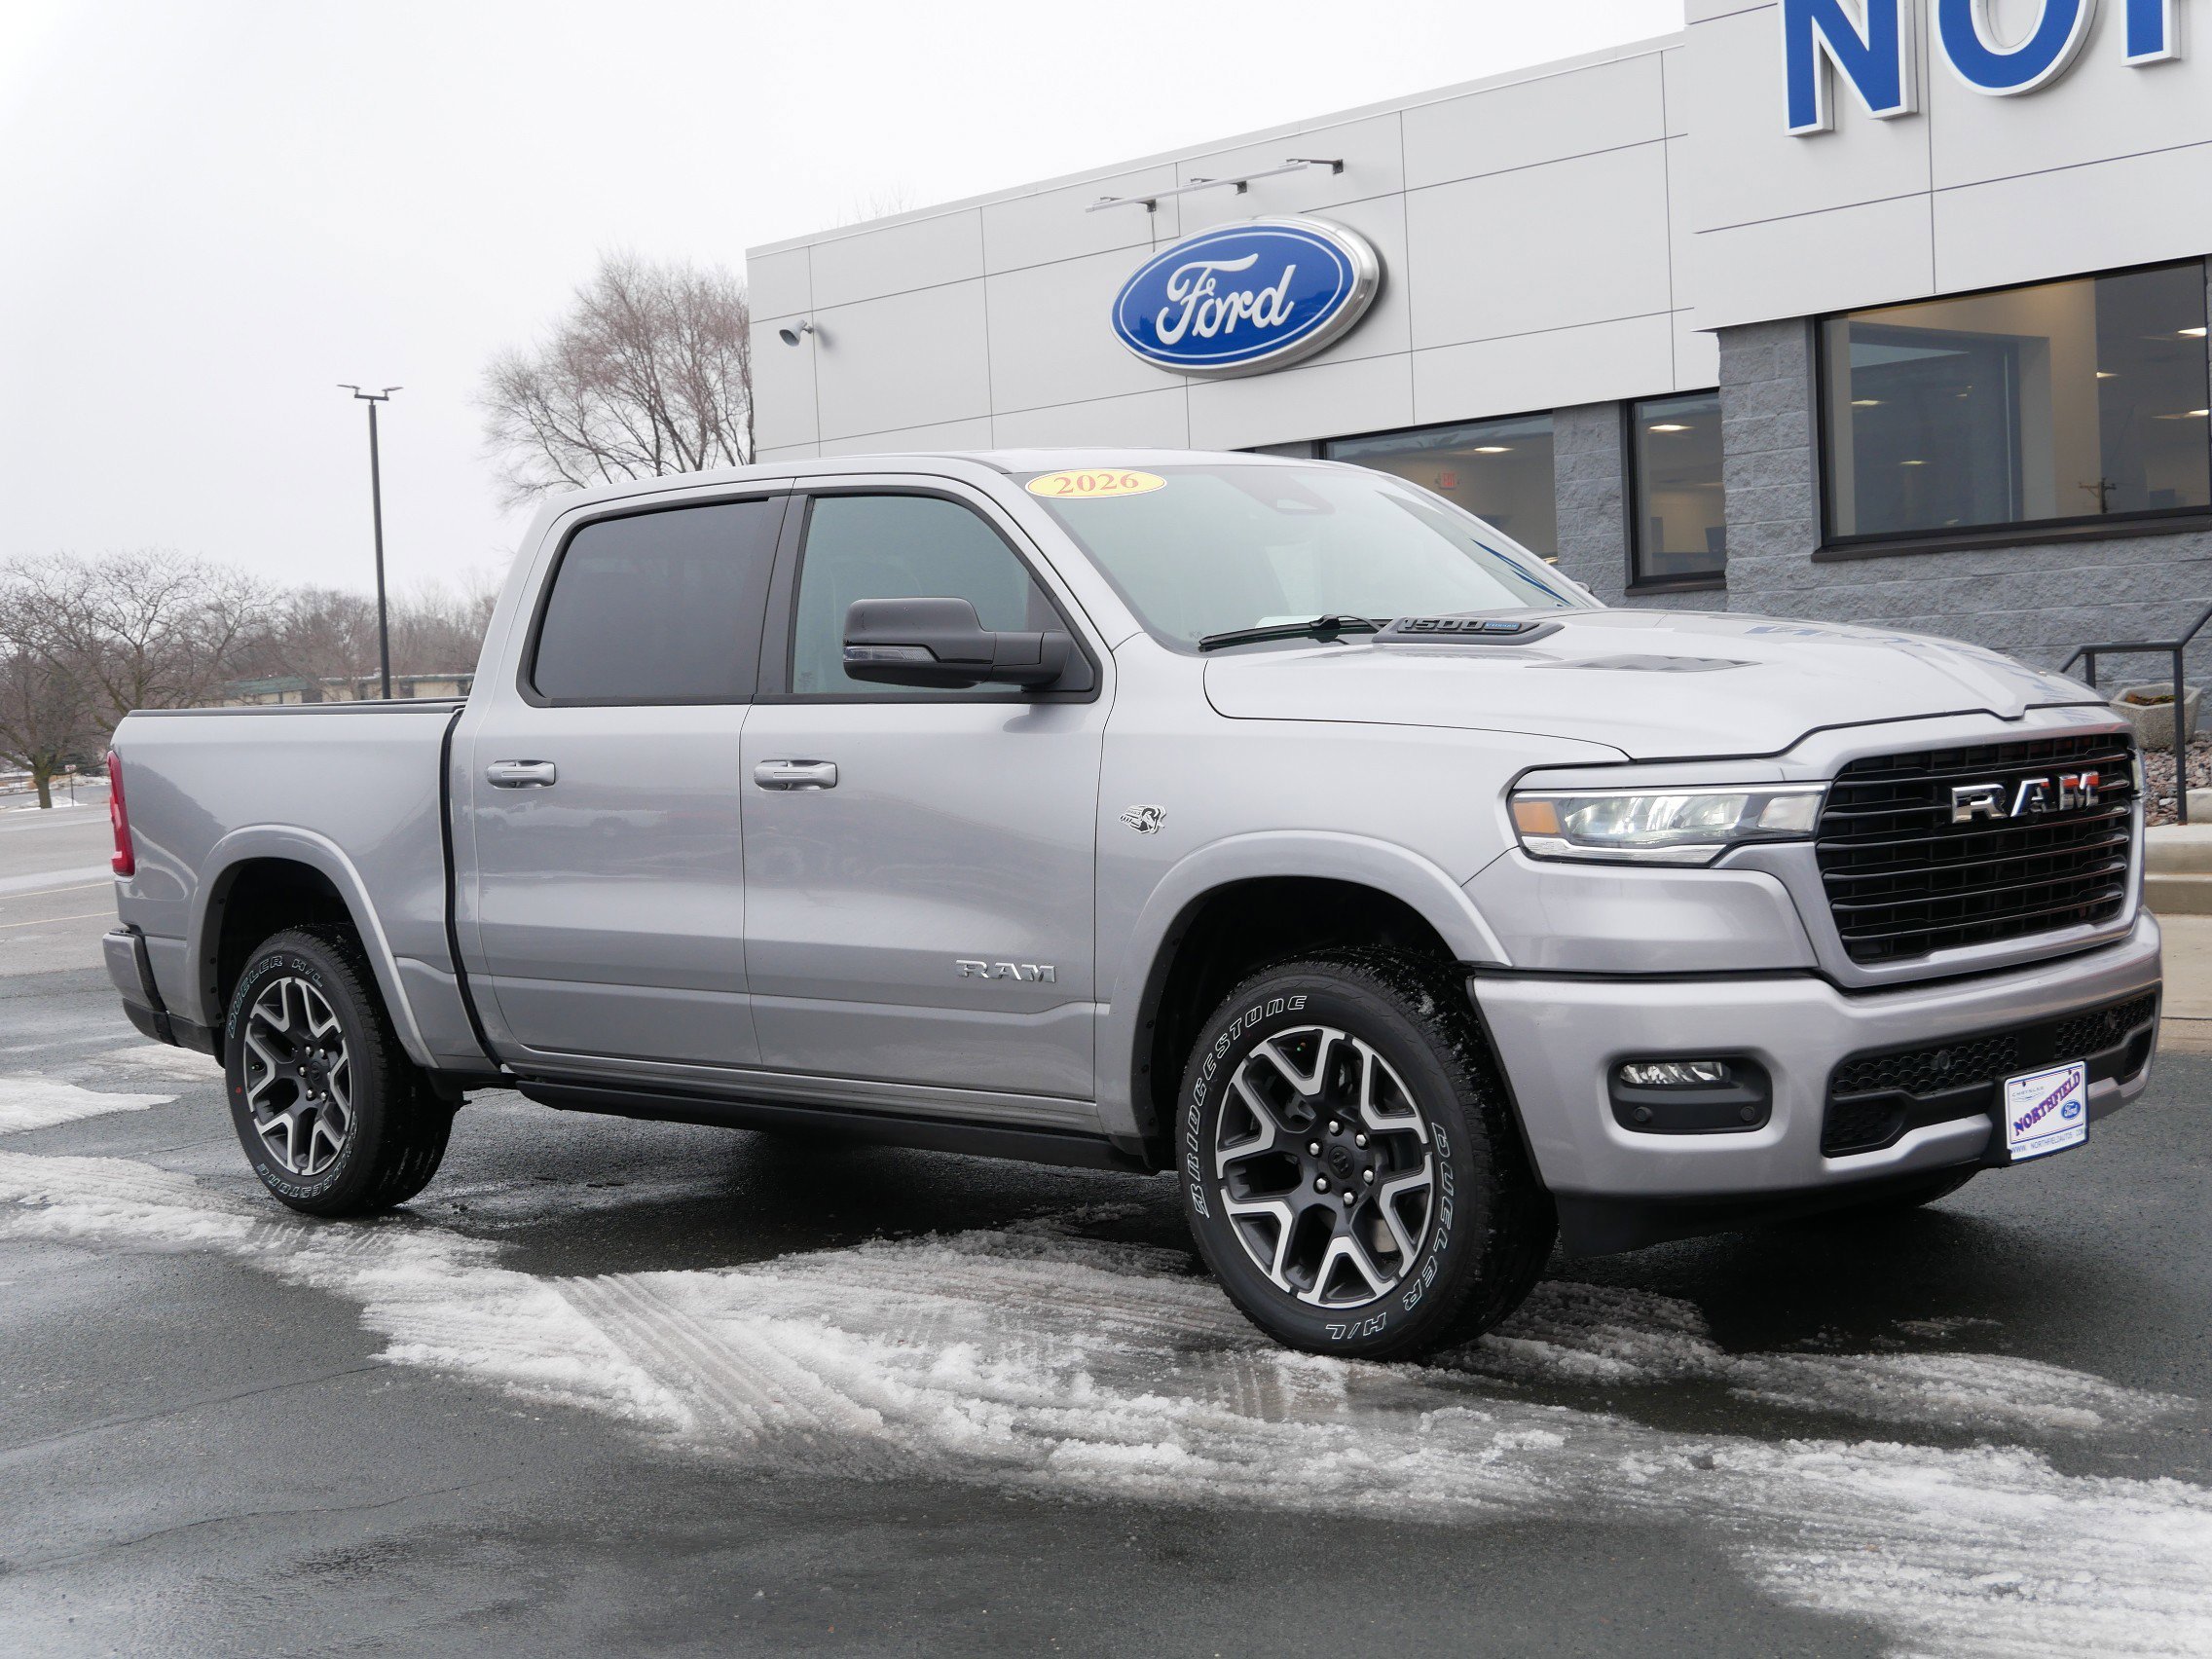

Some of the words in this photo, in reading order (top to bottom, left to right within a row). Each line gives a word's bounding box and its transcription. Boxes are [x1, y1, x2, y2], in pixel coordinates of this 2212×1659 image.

[1780, 0, 2181, 136] NO
[1156, 252, 1296, 346] Ford
[1053, 472, 1139, 495] 2026
[1397, 616, 1482, 632] 1500
[1951, 770, 2100, 825] RAM
[227, 955, 283, 1039] DUELER
[291, 958, 323, 988] H/L
[955, 959, 1056, 983] RAM
[1187, 994, 1308, 1219] BRIDGESTONE
[2012, 1071, 2081, 1136] NORTHFIELD
[1403, 1122, 1456, 1312] DUELER
[1325, 1311, 1387, 1341] H/L
